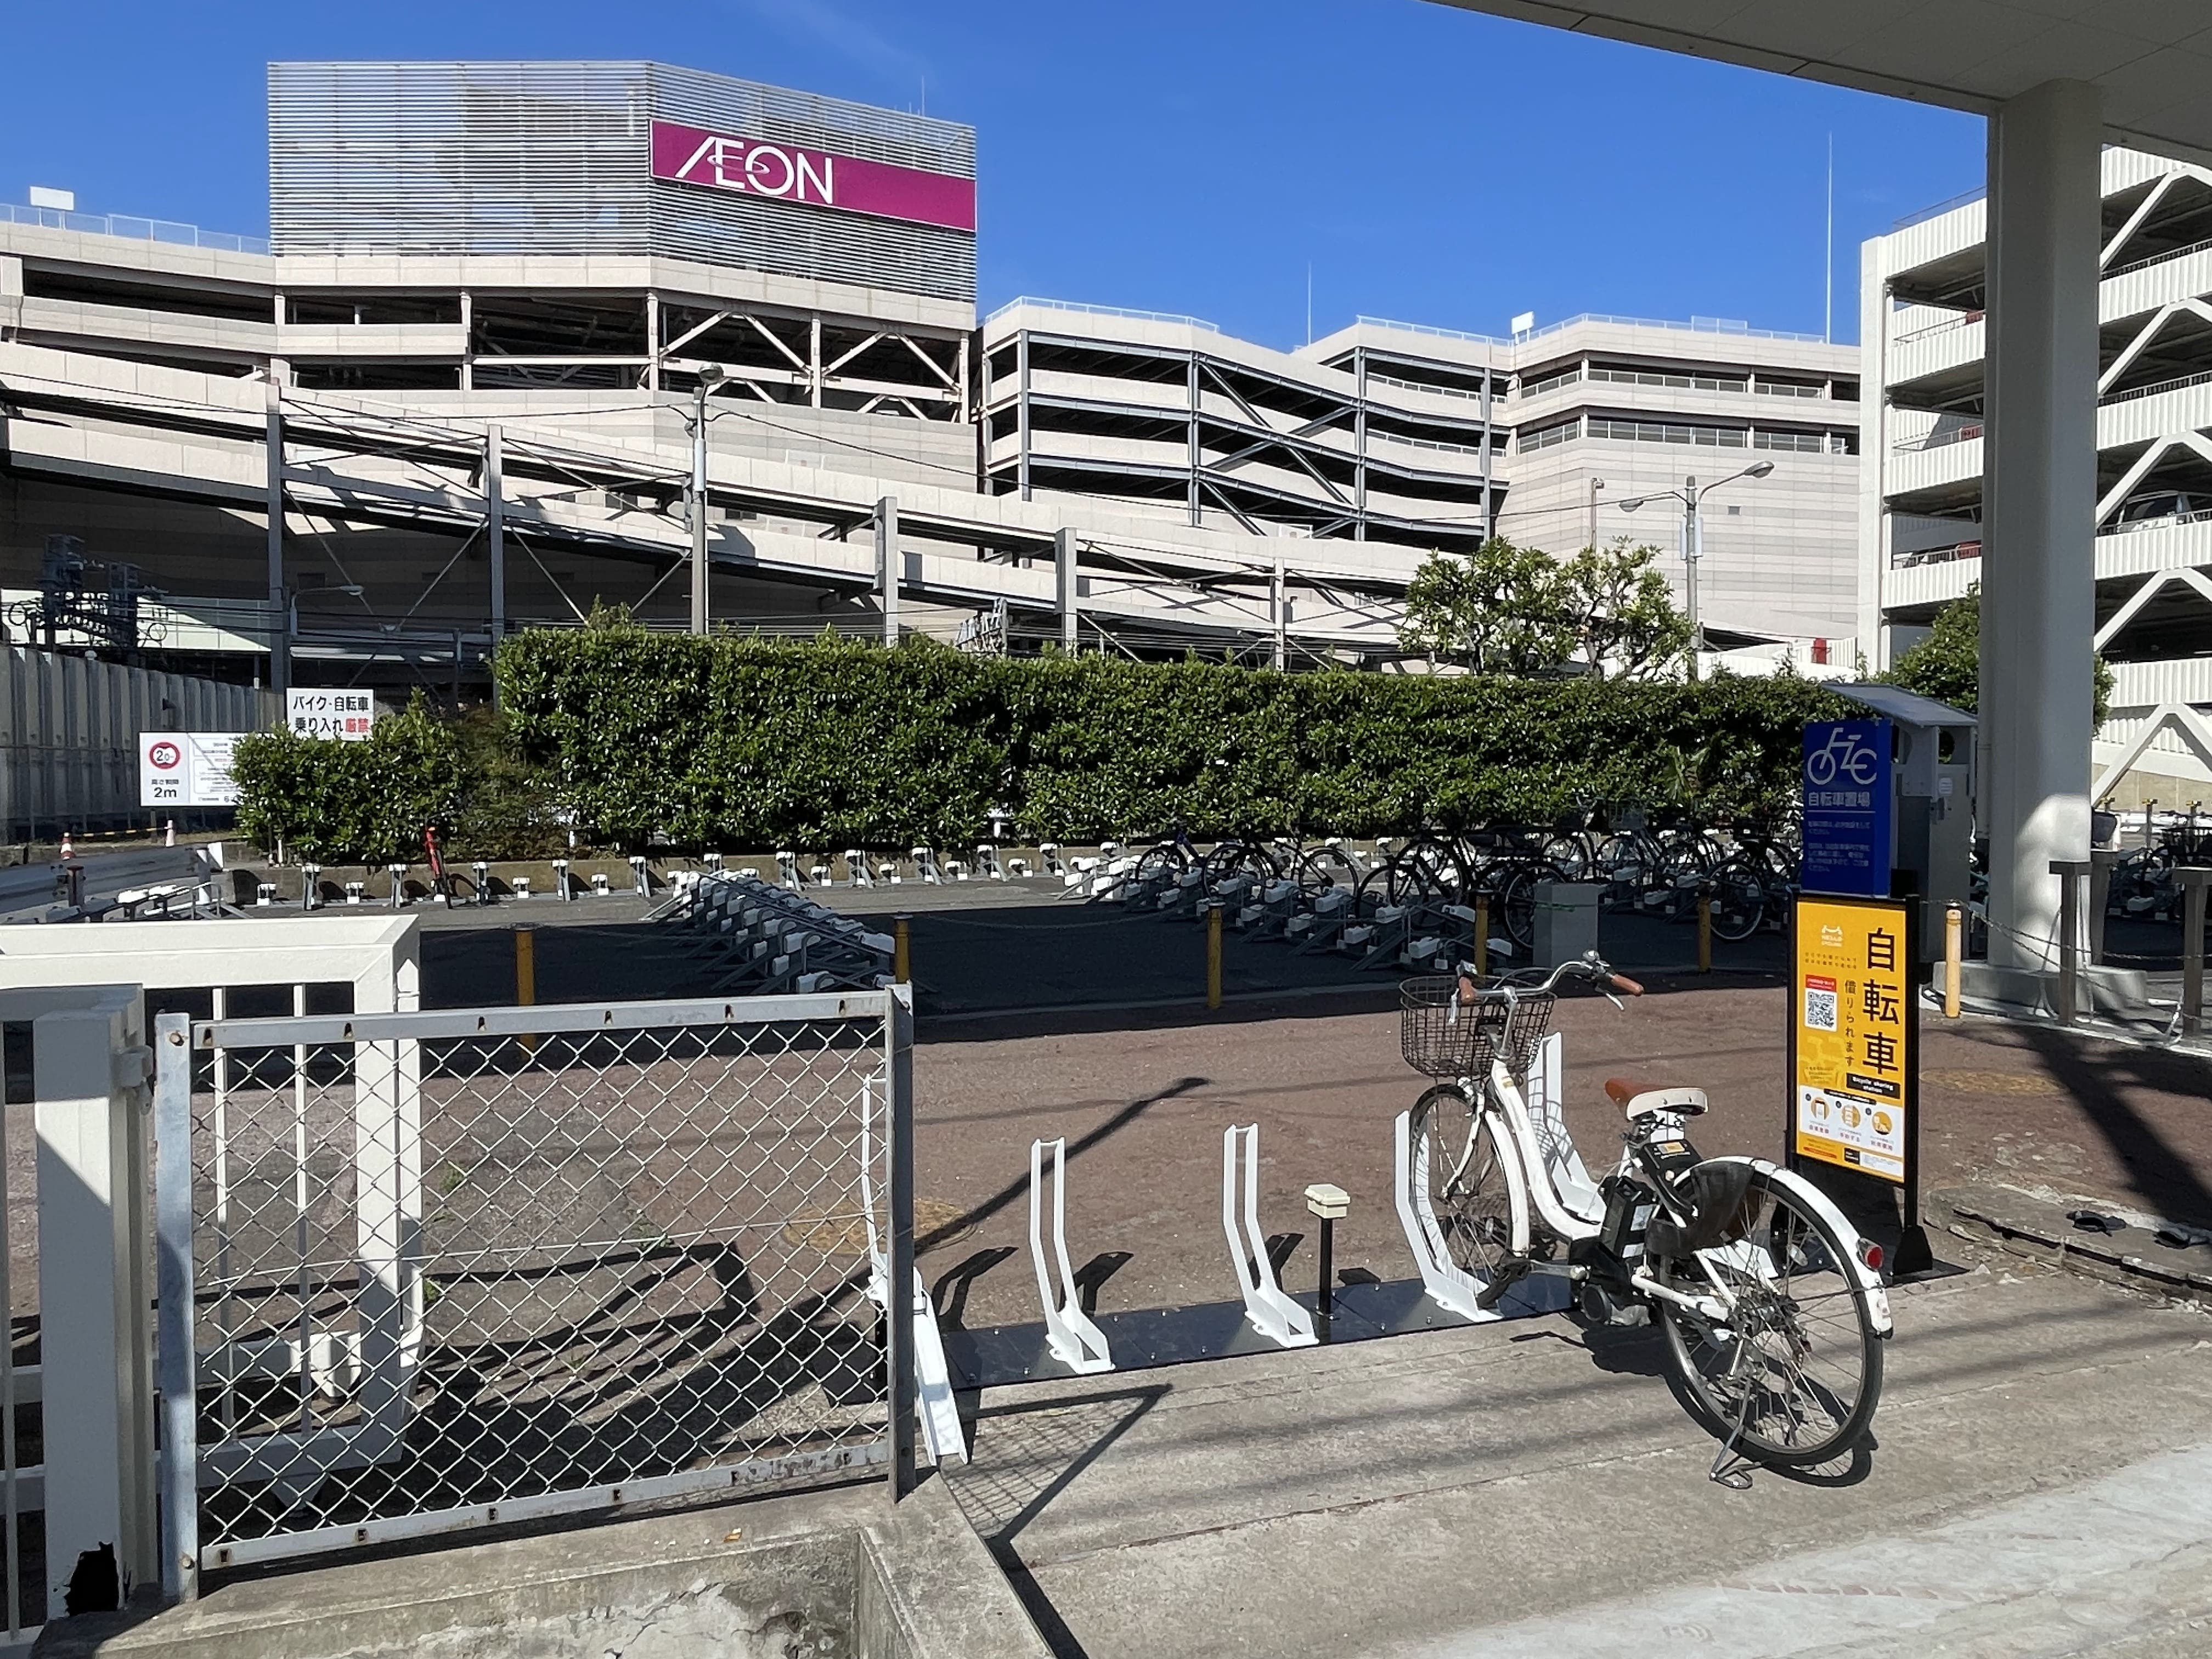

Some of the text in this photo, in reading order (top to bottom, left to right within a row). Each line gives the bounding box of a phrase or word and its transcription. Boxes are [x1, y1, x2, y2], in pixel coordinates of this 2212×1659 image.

[293, 696, 369, 712] バイク・自転車
[154, 787, 177, 798] 2m
[1808, 791, 1871, 807] 自転車置場
[1863, 927, 1899, 1074] 自転車
[1844, 979, 1857, 1066] 借りられます
